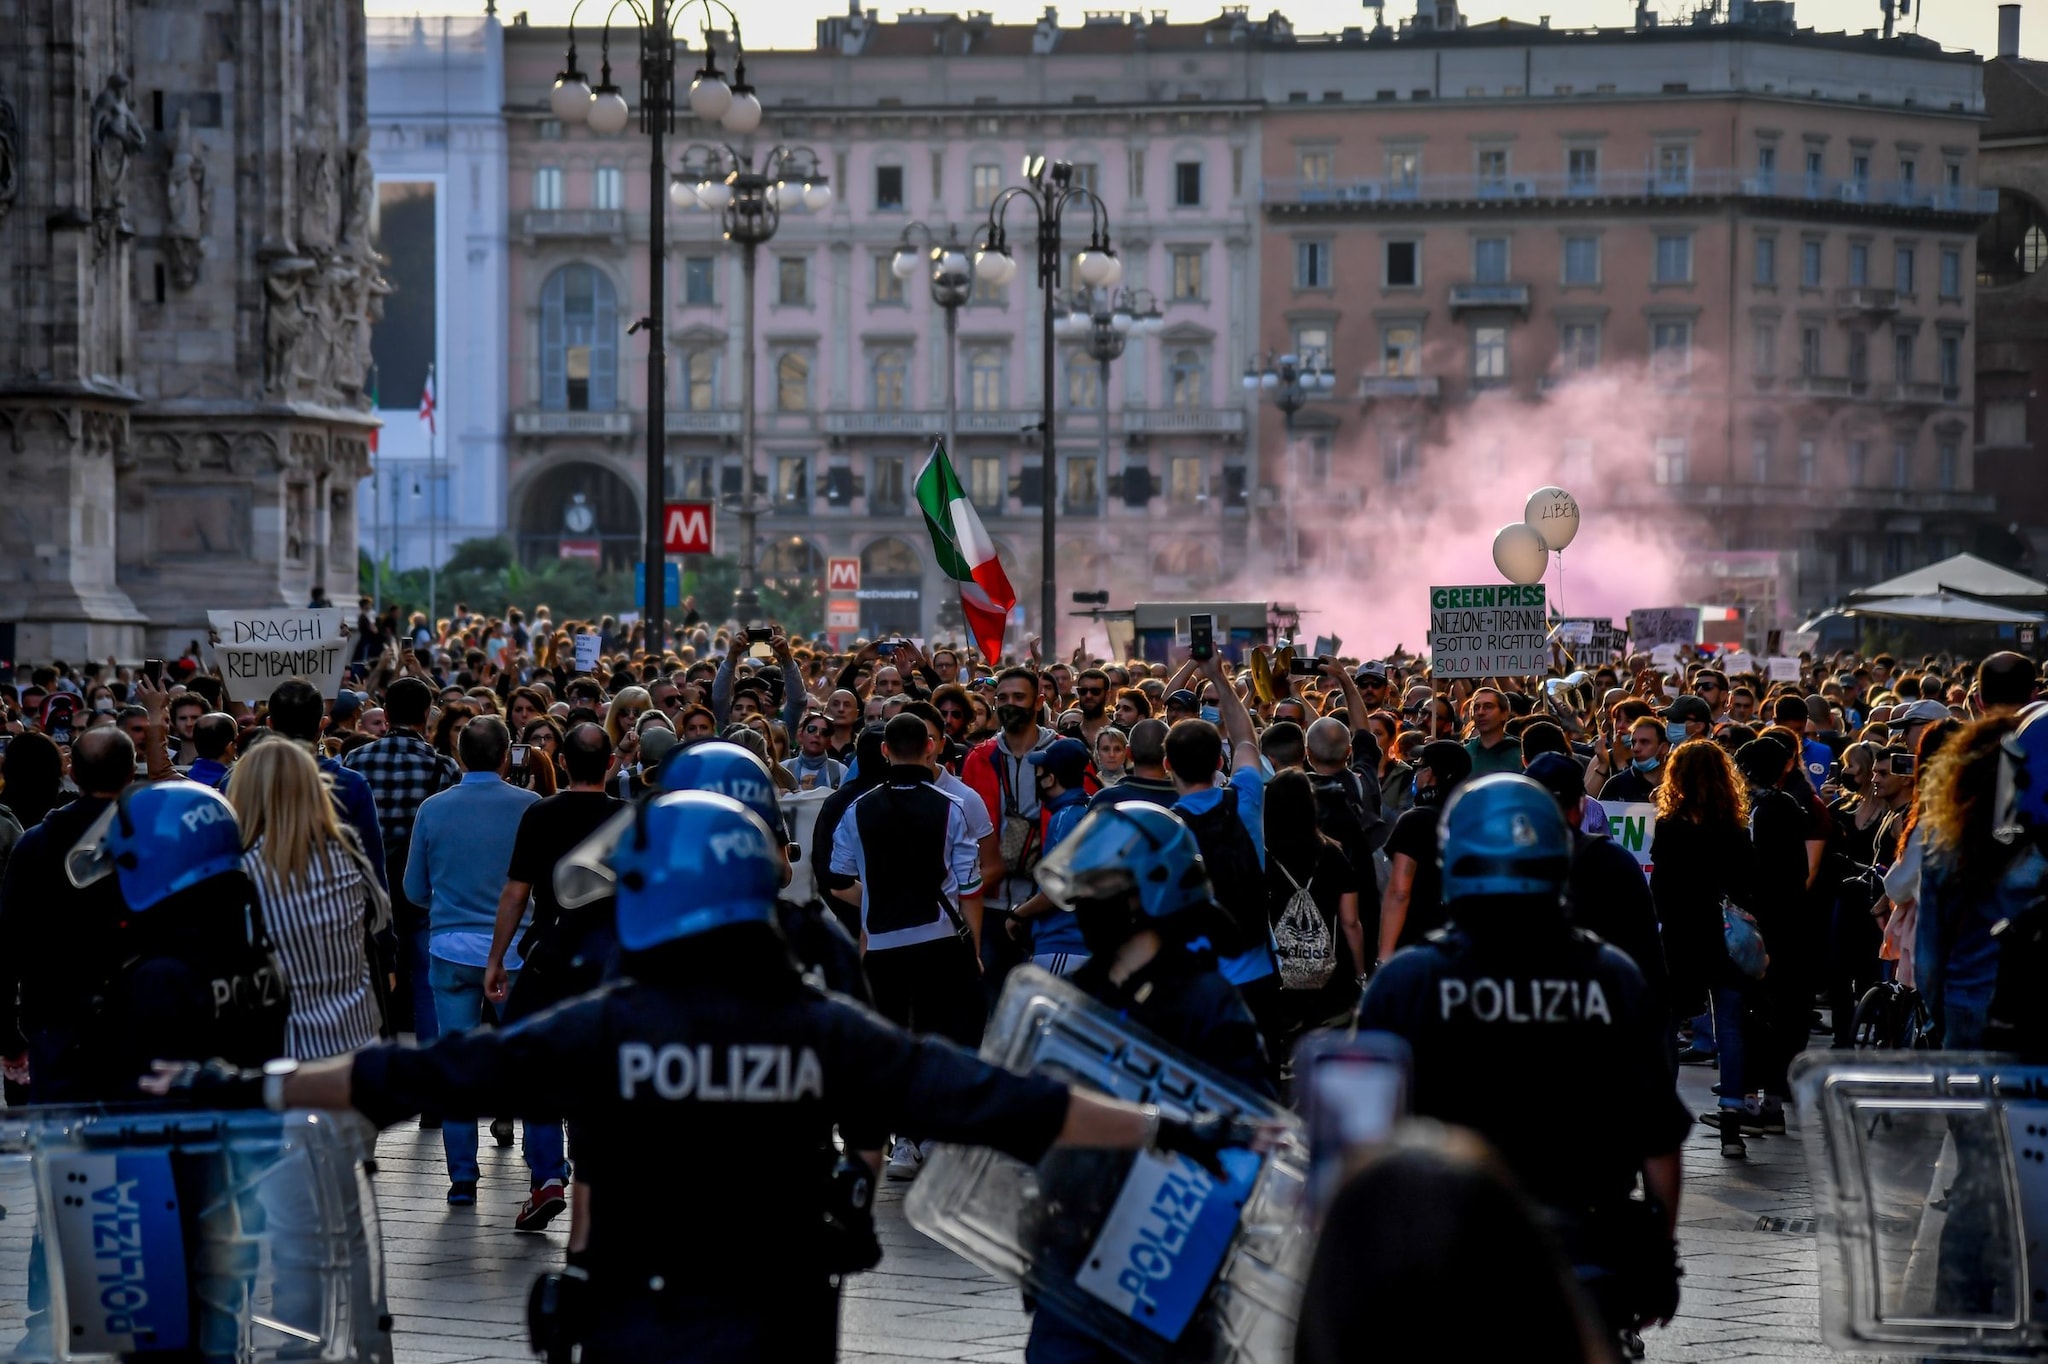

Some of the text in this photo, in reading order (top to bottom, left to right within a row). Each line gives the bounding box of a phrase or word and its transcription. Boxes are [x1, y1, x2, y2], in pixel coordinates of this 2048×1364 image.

[666, 511, 709, 544] M
[832, 564, 857, 584] M
[1432, 585, 1546, 609] GREEN PASS
[1491, 610, 1547, 632] TIRANNIA
[1436, 636, 1482, 652] SOTTO
[1487, 634, 1545, 651] RICATTO
[1436, 654, 1545, 673] SOLO IN ITALIA
[1440, 977, 1612, 1025] POLIZIA
[618, 1041, 823, 1101] POLIZIA
[91, 1178, 155, 1335] POLIZIA
